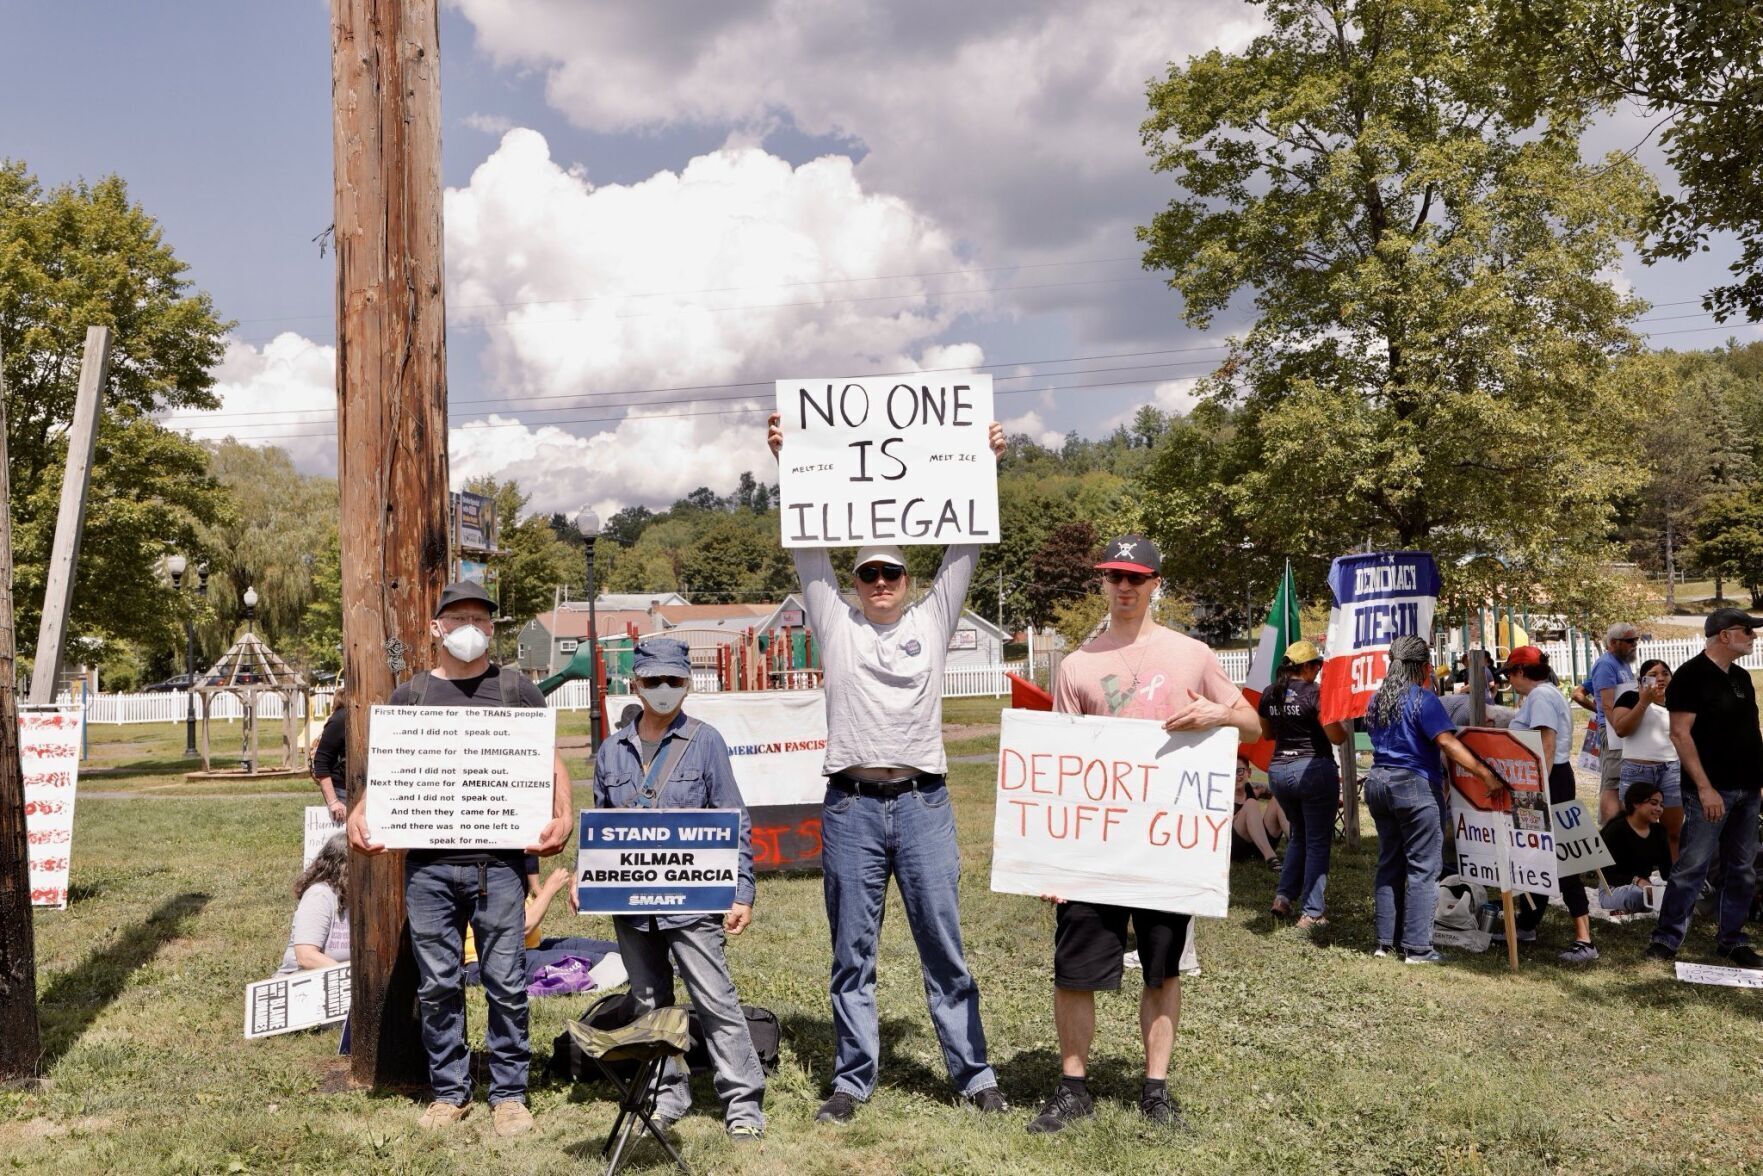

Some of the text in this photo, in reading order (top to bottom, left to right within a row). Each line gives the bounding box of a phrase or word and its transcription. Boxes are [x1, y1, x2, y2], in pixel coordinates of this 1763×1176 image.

[799, 384, 973, 430] NO ONE
[848, 437, 908, 482] IS
[929, 453, 977, 463] MELT ICE
[791, 463, 834, 474] MELT ICE
[788, 497, 989, 542] ILLEGAL
[374, 708, 395, 716] First
[397, 709, 417, 718] they
[445, 709, 459, 717] for
[482, 709, 512, 717] TRANS
[514, 710, 547, 719] people.
[464, 729, 491, 737] speak
[371, 747, 394, 755] Then
[396, 748, 416, 756] they
[480, 748, 541, 757] IMMIGRANTS.
[728, 743, 782, 757] MERICAN
[462, 767, 489, 776] speak
[370, 779, 392, 787] Next
[394, 779, 414, 788] they
[442, 779, 456, 787] for
[461, 780, 509, 788] AMERICAN
[510, 780, 551, 788] CITIZENS
[1000, 748, 1231, 813] DEPORT ME
[461, 794, 487, 803] speak
[489, 794, 508, 802] out.
[434, 808, 454, 817] they
[486, 808, 500, 816] for
[1554, 806, 1582, 830] UP
[1008, 800, 1229, 852] TUFF GUY
[587, 827, 731, 841] I STAND WITH
[429, 837, 456, 846] speak
[459, 837, 472, 845] for
[1556, 835, 1603, 862] OUT!
[620, 852, 695, 866] KILMAR
[581, 869, 734, 882] ABREGO GARCIA
[1458, 853, 1552, 888] Families
[628, 893, 687, 906] SMART
[269, 997, 286, 1030] BLAME
